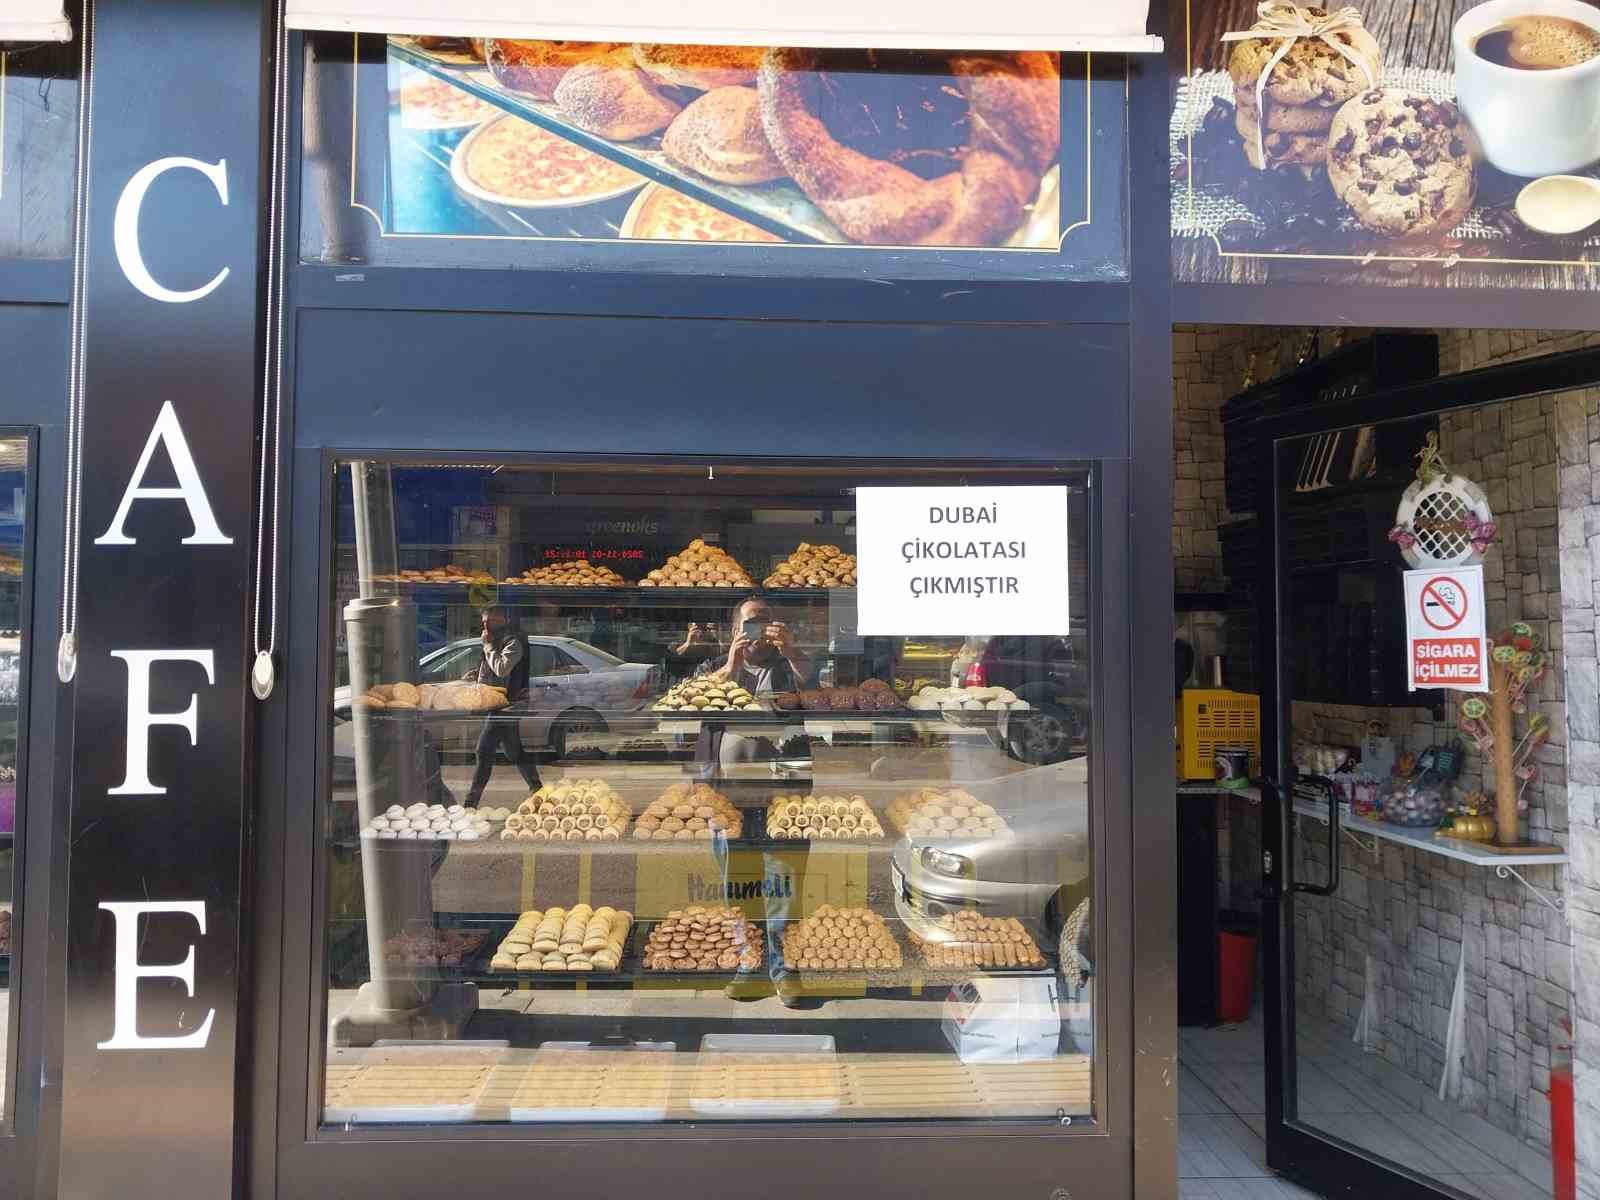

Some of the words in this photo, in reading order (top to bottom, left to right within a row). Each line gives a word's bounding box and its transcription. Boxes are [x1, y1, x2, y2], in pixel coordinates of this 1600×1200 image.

[929, 502, 998, 524] DUBAİ
[901, 537, 1026, 563] ÇİKOLATASI
[910, 576, 1020, 598] ÇIKMIŞTIR
[94, 156, 234, 1050] CAFE
[1416, 641, 1477, 659] SİGARA
[1415, 660, 1479, 682] İÇİLMEZ
